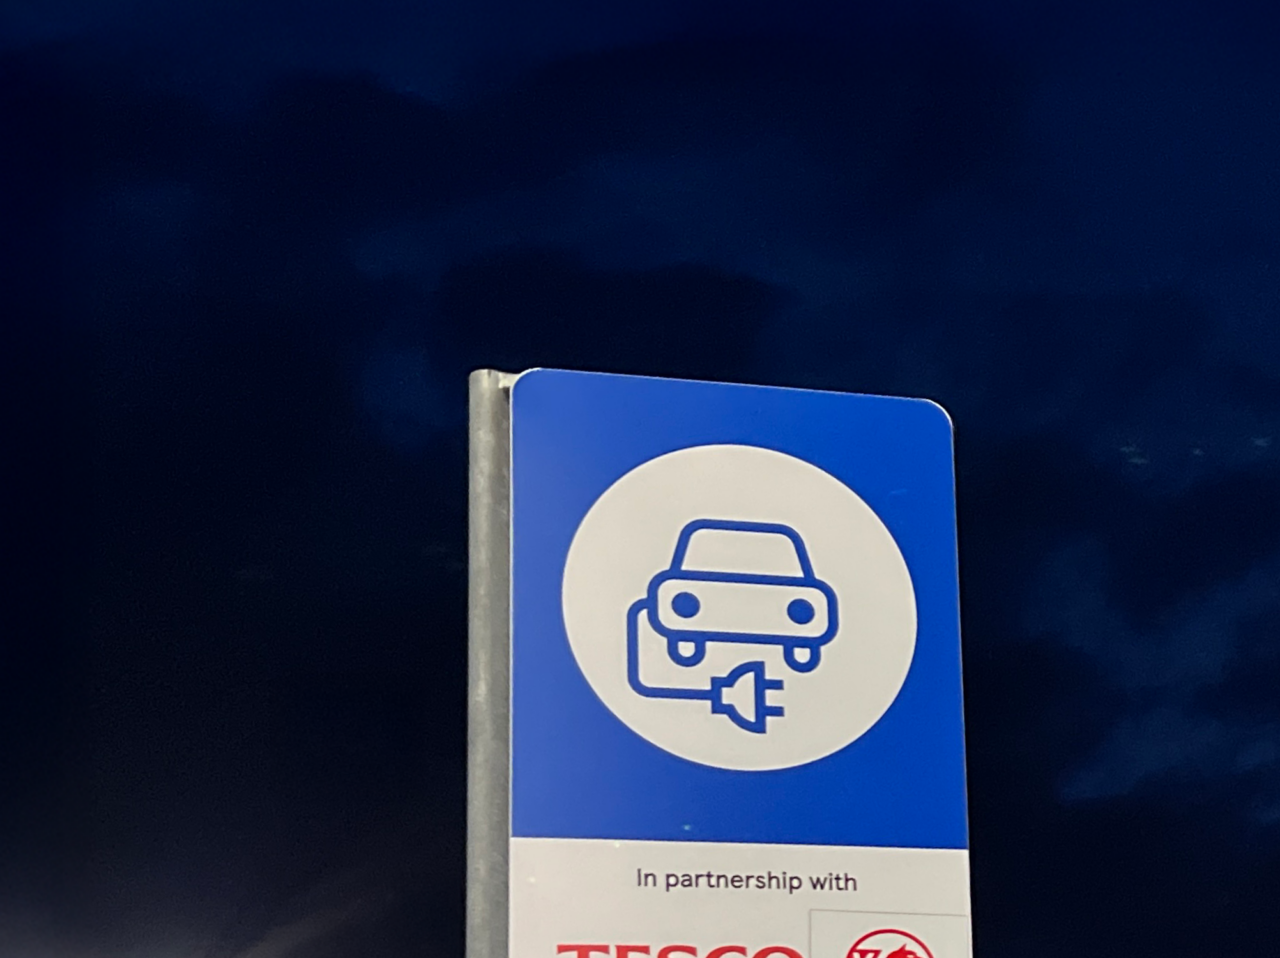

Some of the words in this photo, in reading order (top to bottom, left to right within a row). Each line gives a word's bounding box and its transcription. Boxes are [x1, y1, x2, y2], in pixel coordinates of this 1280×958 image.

[637, 868, 657, 887] In
[665, 870, 803, 895] partnership
[809, 872, 858, 891] with
